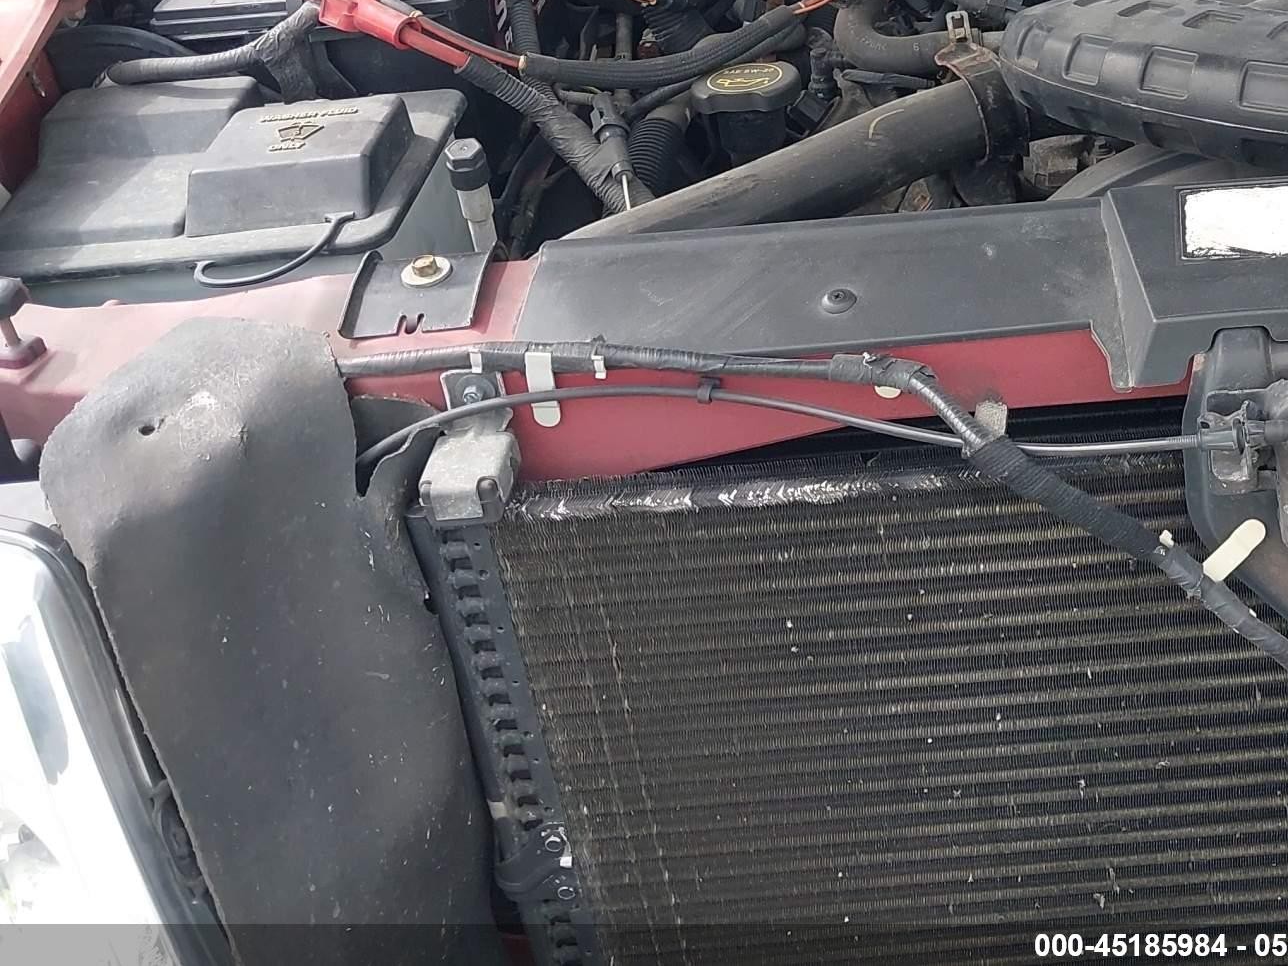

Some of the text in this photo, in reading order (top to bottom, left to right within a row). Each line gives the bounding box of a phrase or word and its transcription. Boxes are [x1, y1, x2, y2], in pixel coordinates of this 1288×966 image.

[260, 106, 359, 123] WASHER FLUID
[268, 142, 306, 152] ONLY
